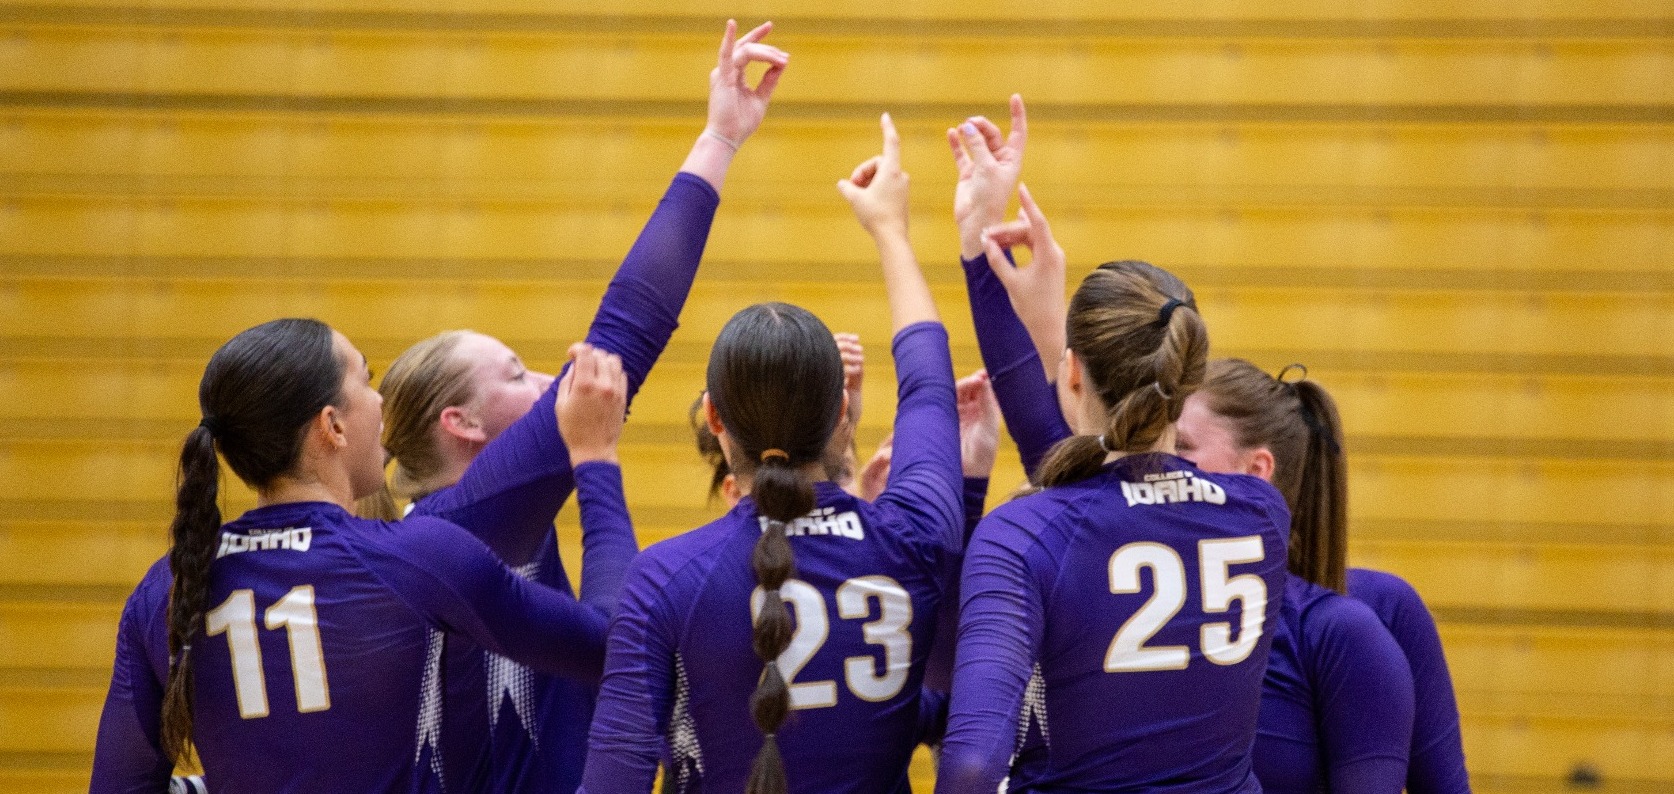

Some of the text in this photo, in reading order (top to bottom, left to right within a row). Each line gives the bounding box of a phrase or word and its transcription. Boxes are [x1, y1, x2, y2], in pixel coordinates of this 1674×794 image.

[216, 527, 312, 559] IDAHO
[1120, 477, 1226, 507] IDAHO
[205, 584, 331, 719] 11
[751, 574, 913, 710] 23
[1103, 535, 1268, 673] 25
